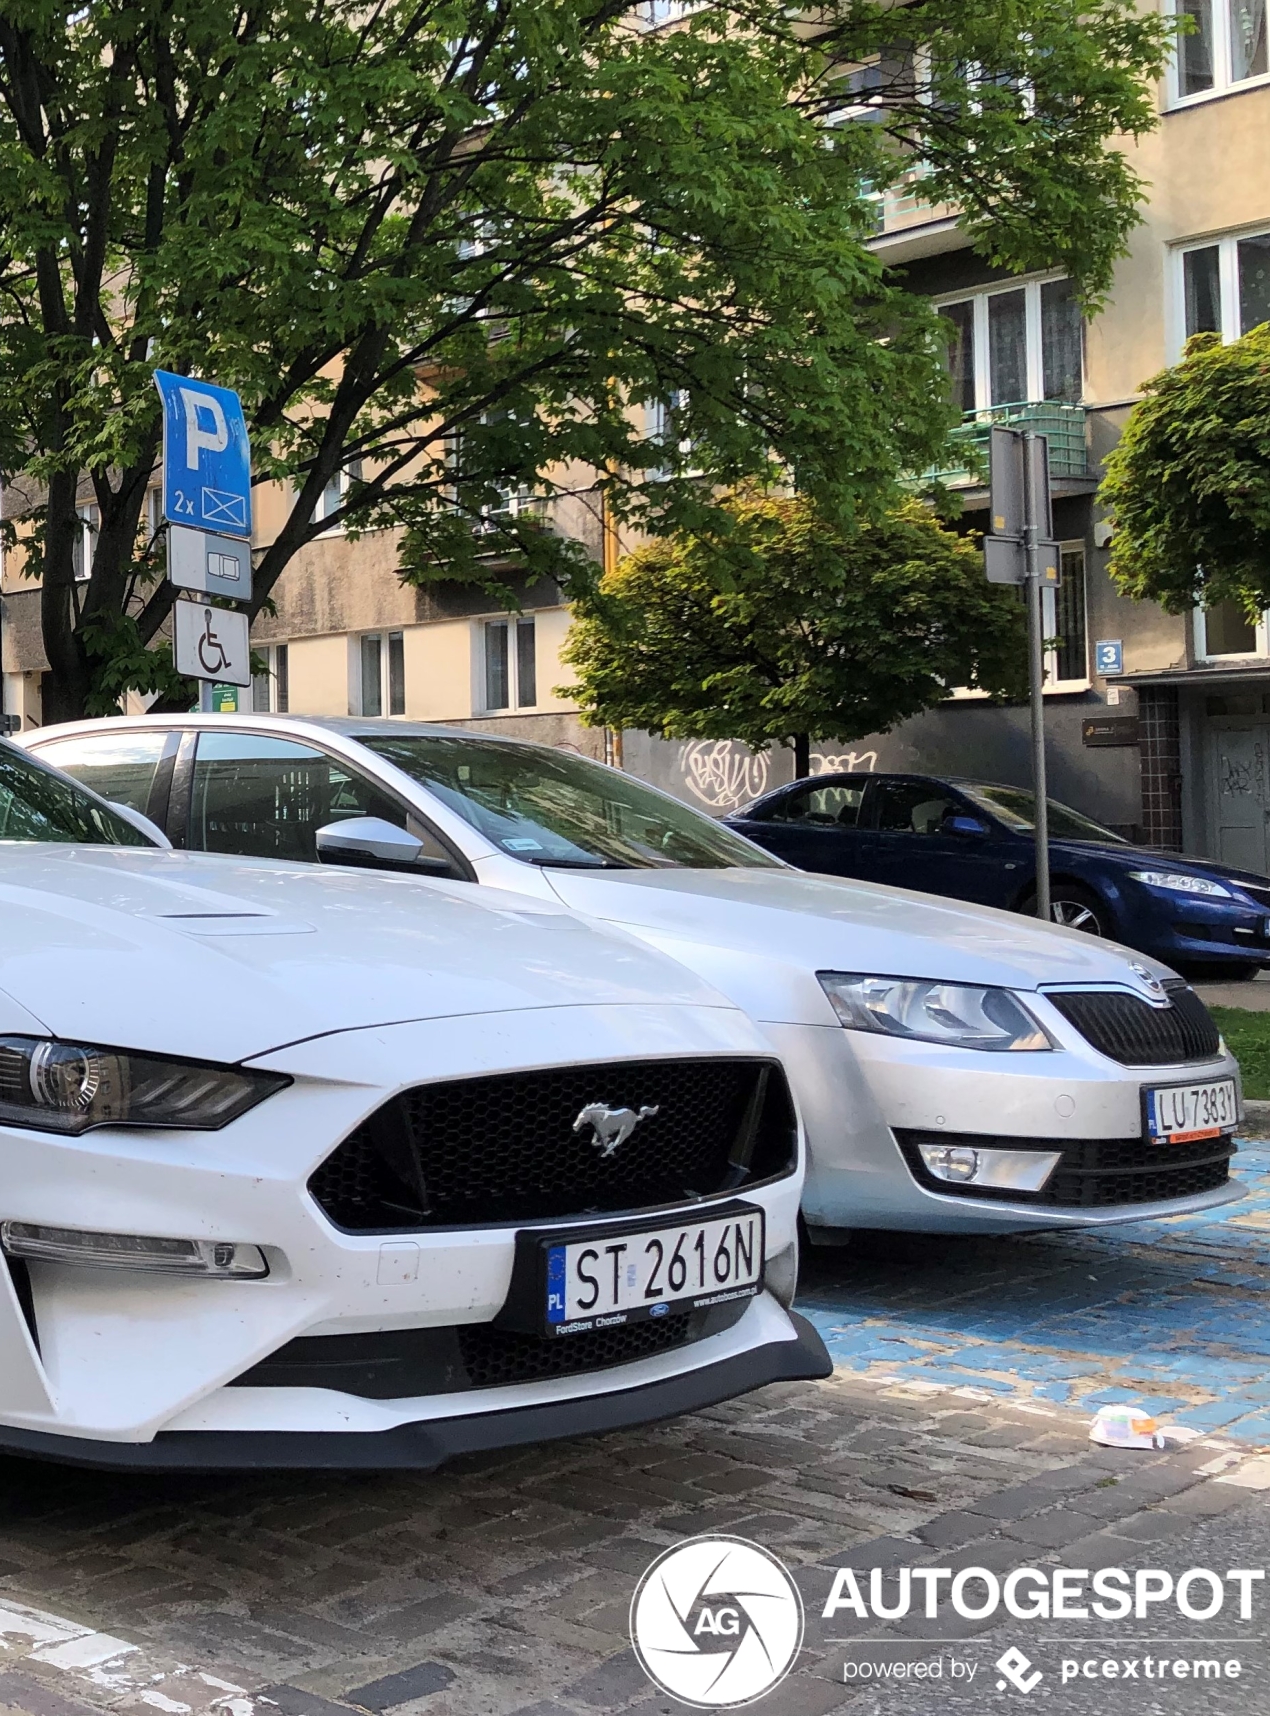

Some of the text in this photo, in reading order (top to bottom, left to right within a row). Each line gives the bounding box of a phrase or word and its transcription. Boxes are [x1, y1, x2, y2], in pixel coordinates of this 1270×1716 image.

[179, 387, 228, 470] P
[174, 490, 194, 515] 2x
[1102, 646, 1116, 663] 3
[1159, 1085, 1233, 1131] LU 7383Y
[576, 1220, 754, 1310] ST 2616N
[548, 1293, 564, 1312] PL
[555, 1320, 593, 1336] FordStore
